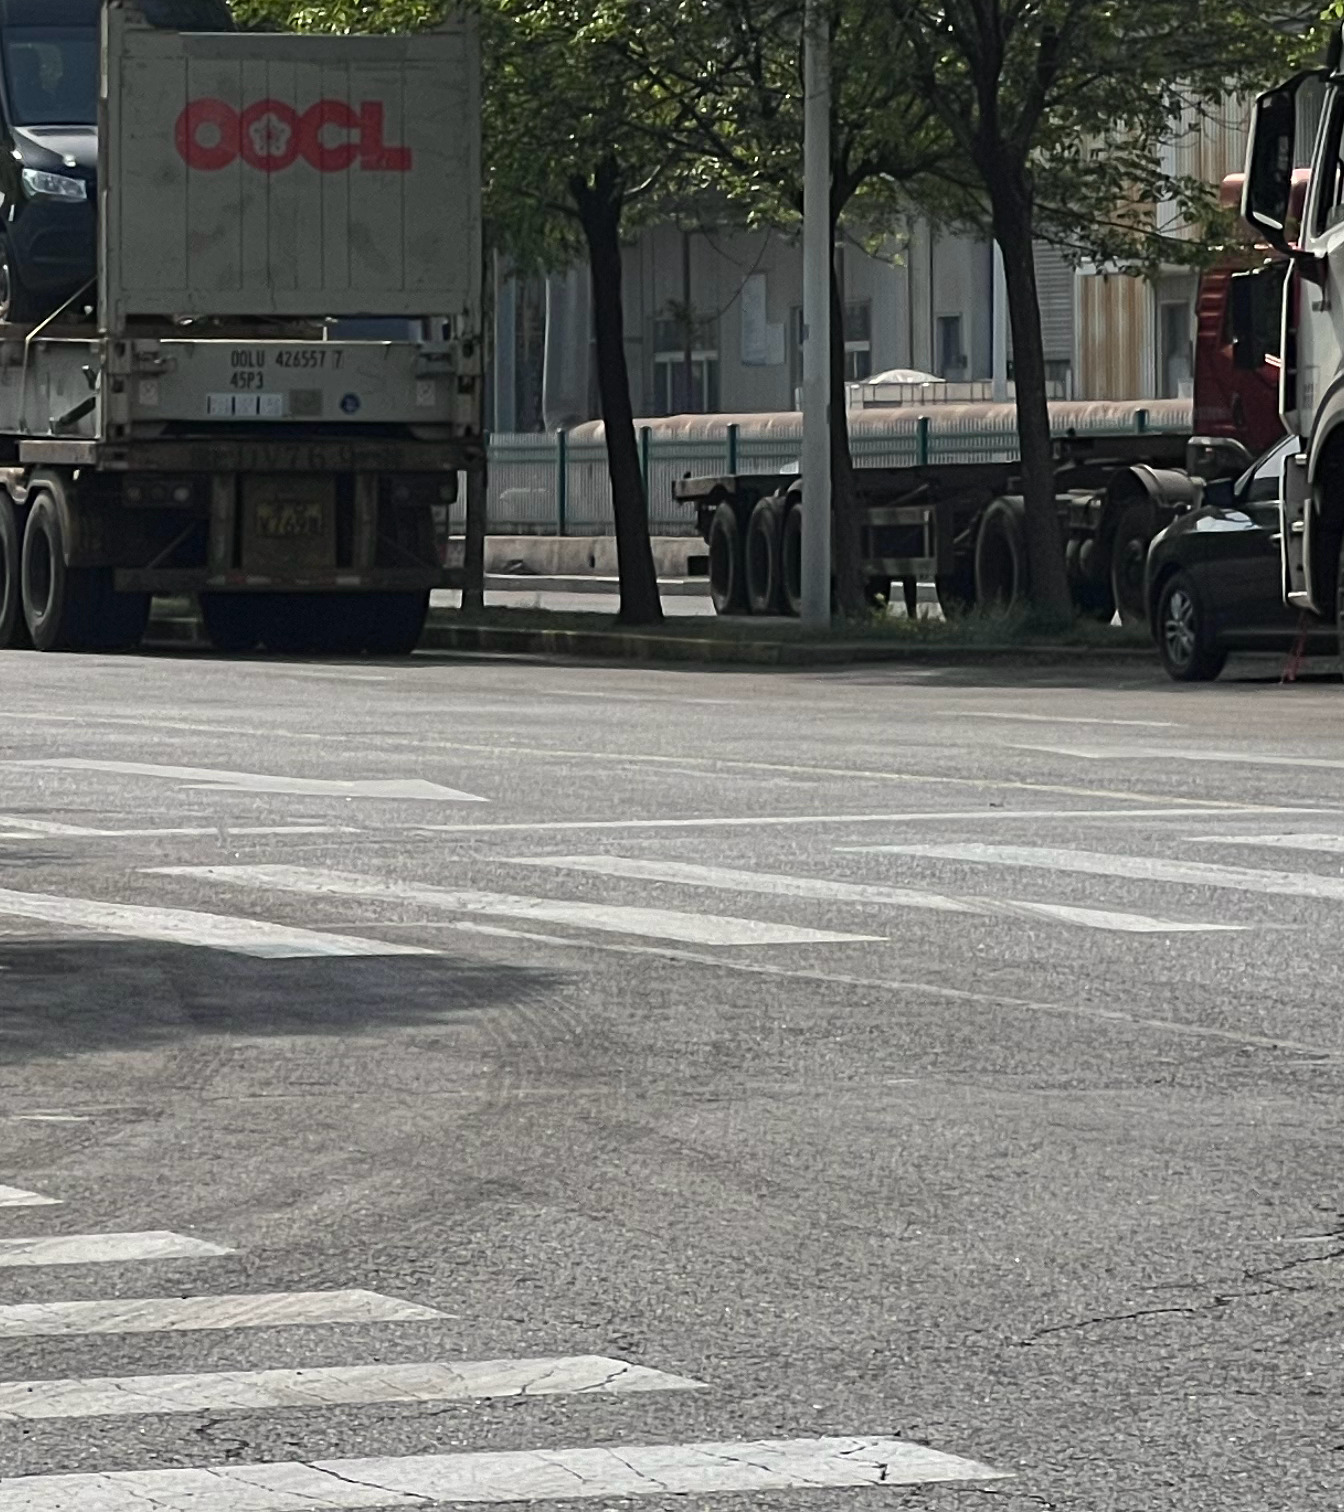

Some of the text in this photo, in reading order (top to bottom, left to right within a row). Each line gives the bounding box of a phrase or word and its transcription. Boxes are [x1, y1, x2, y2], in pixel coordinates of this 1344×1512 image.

[175, 98, 412, 172] OOCL
[275, 351, 326, 368] 426557
[230, 372, 264, 388] 45P3
